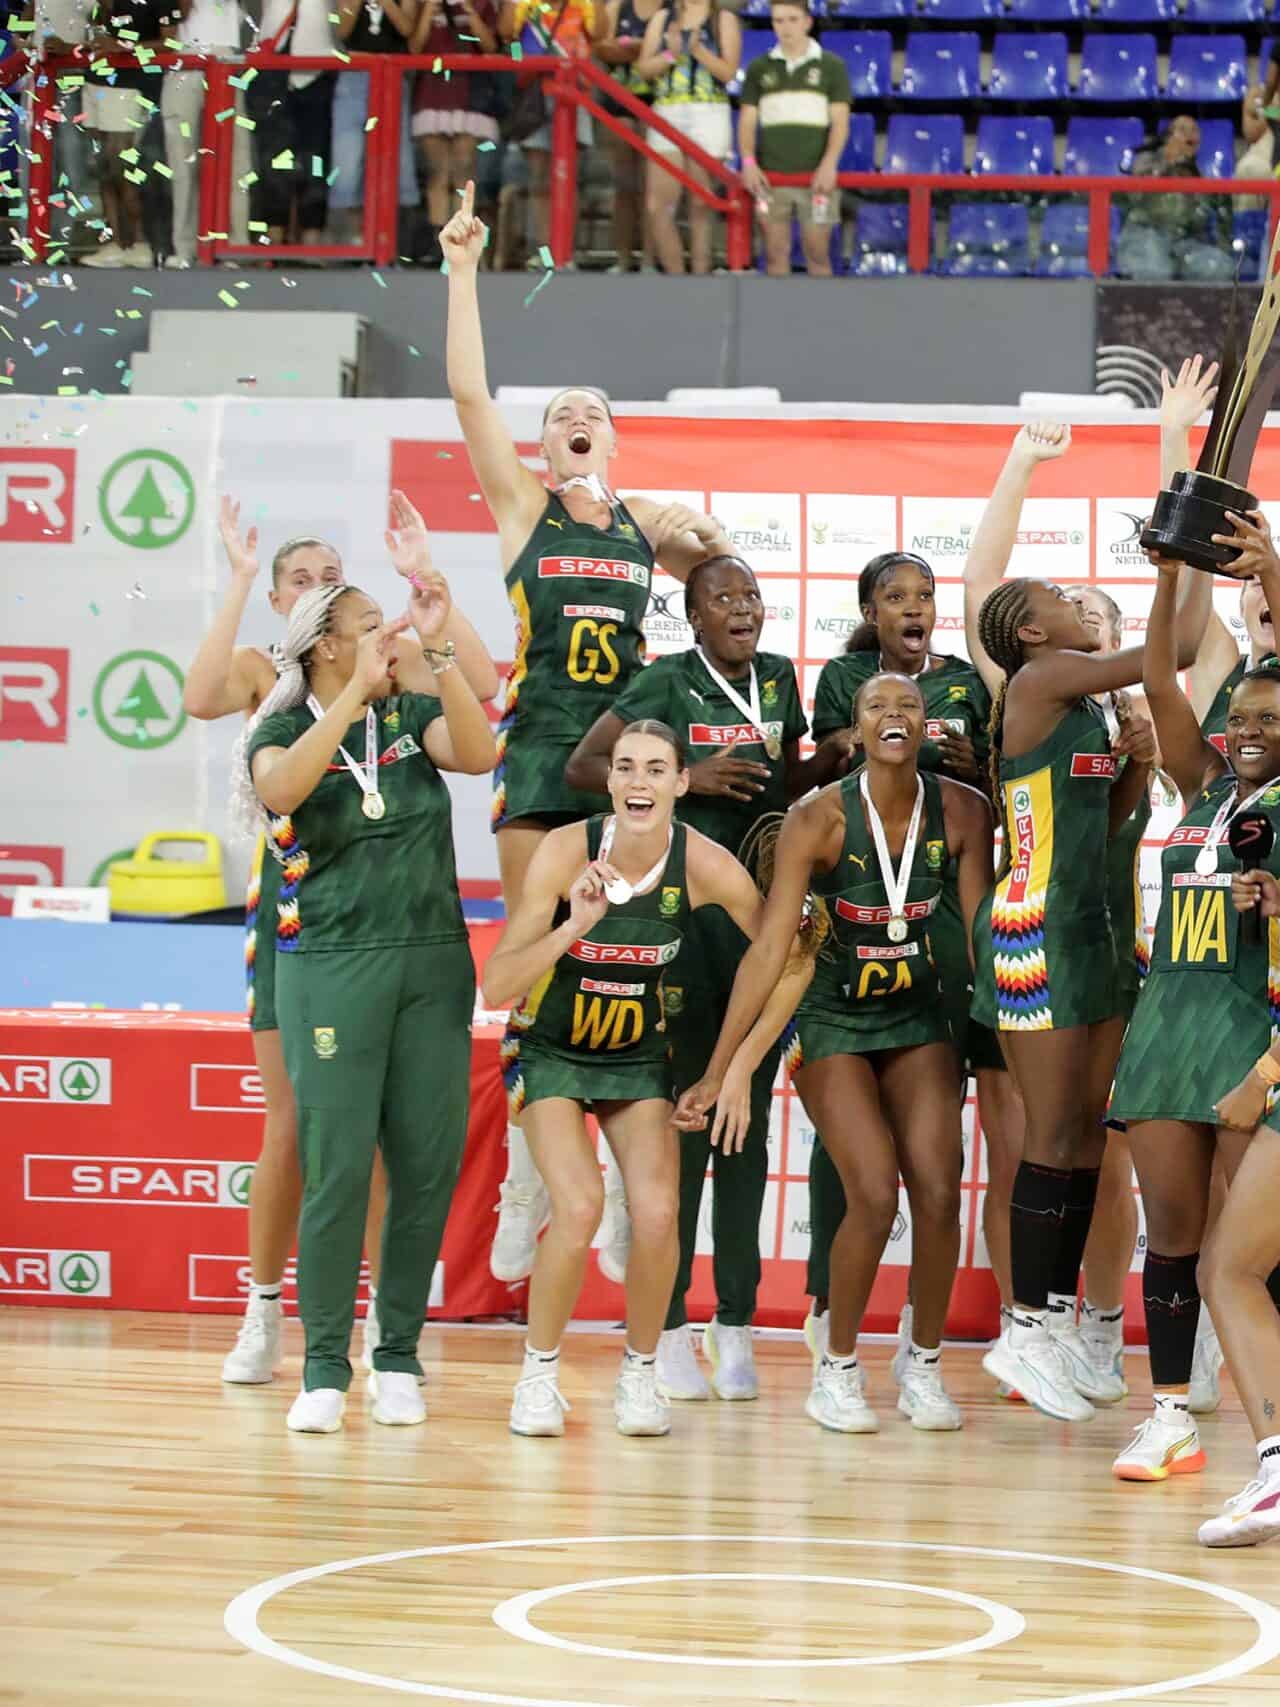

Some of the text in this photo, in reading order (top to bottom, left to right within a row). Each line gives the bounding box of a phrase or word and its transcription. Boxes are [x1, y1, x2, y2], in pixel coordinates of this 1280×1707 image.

[911, 535, 973, 551] NETBAL
[1017, 532, 1067, 544] SPAR
[559, 560, 629, 578] SPAR
[815, 618, 857, 633] NETB
[567, 618, 619, 685] GS
[1091, 758, 1115, 773] SPA
[1171, 889, 1228, 963] WA
[580, 944, 657, 962] SPAR
[570, 993, 644, 1050] WD
[72, 1165, 217, 1197] SPAR
